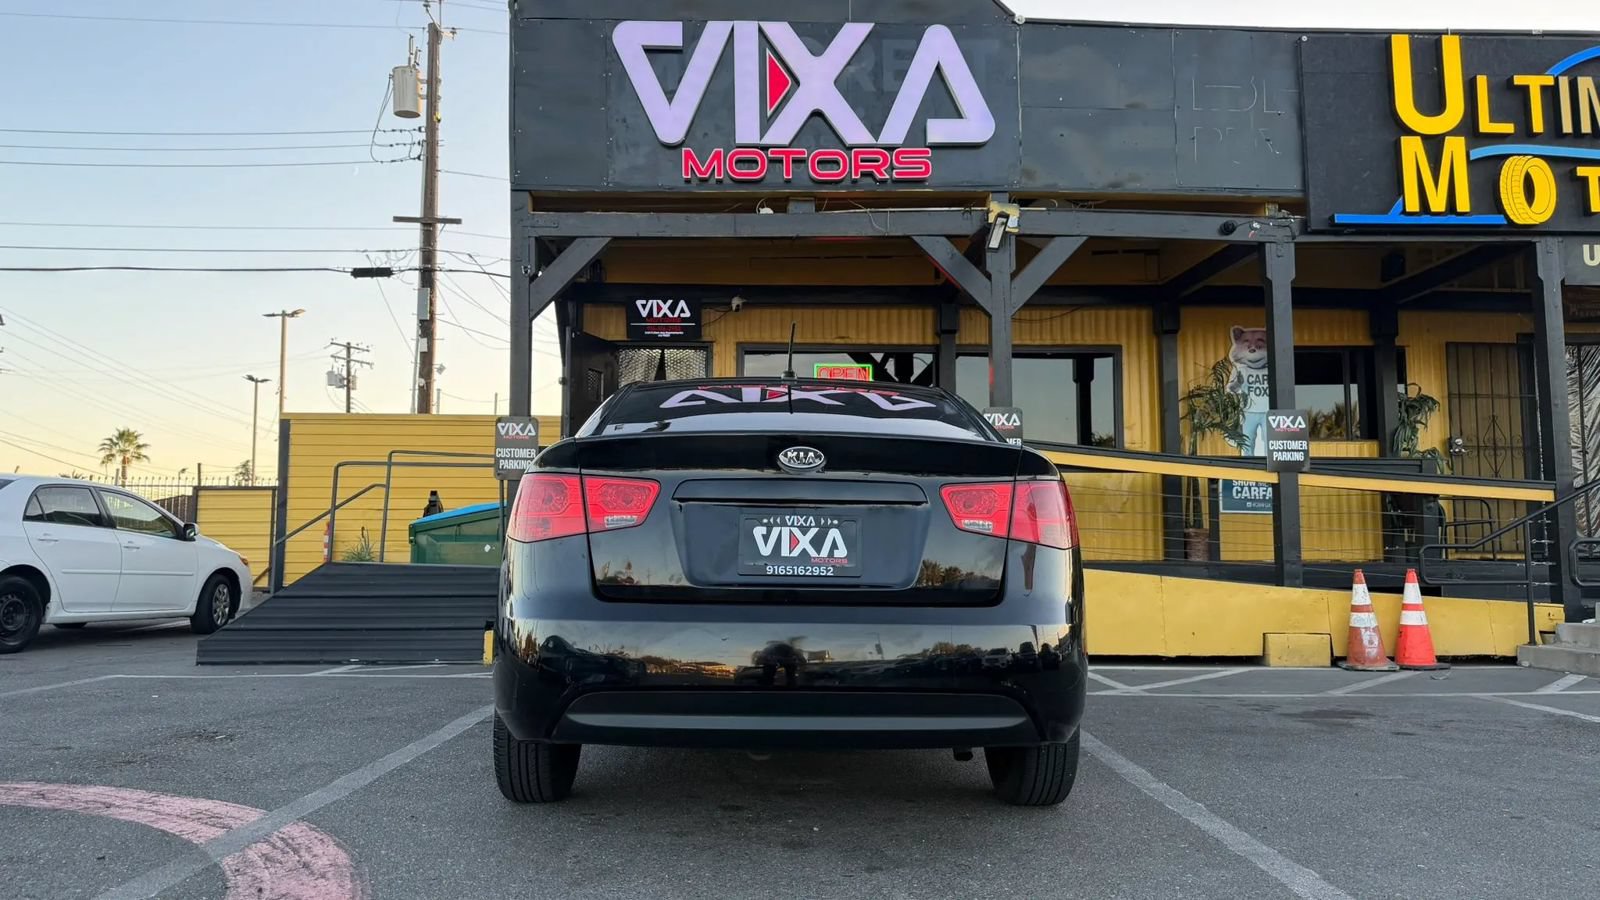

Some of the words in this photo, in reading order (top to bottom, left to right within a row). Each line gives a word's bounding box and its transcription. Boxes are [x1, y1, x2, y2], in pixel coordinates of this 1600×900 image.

[612, 21, 996, 145] VIXA
[681, 148, 932, 182] MOTORS
[635, 299, 691, 318] VIXA
[1247, 386, 1270, 397] FOX
[1268, 415, 1306, 428] VIXA
[497, 422, 536, 436] VIXA
[1269, 440, 1308, 450] CUSTOMER
[496, 447, 536, 458] CUSTOMER
[786, 450, 817, 466] KIA
[1273, 451, 1305, 461] PARKING
[785, 515, 816, 527] VIXA
[752, 526, 848, 558] VIXA
[766, 565, 834, 576] 9165162952
